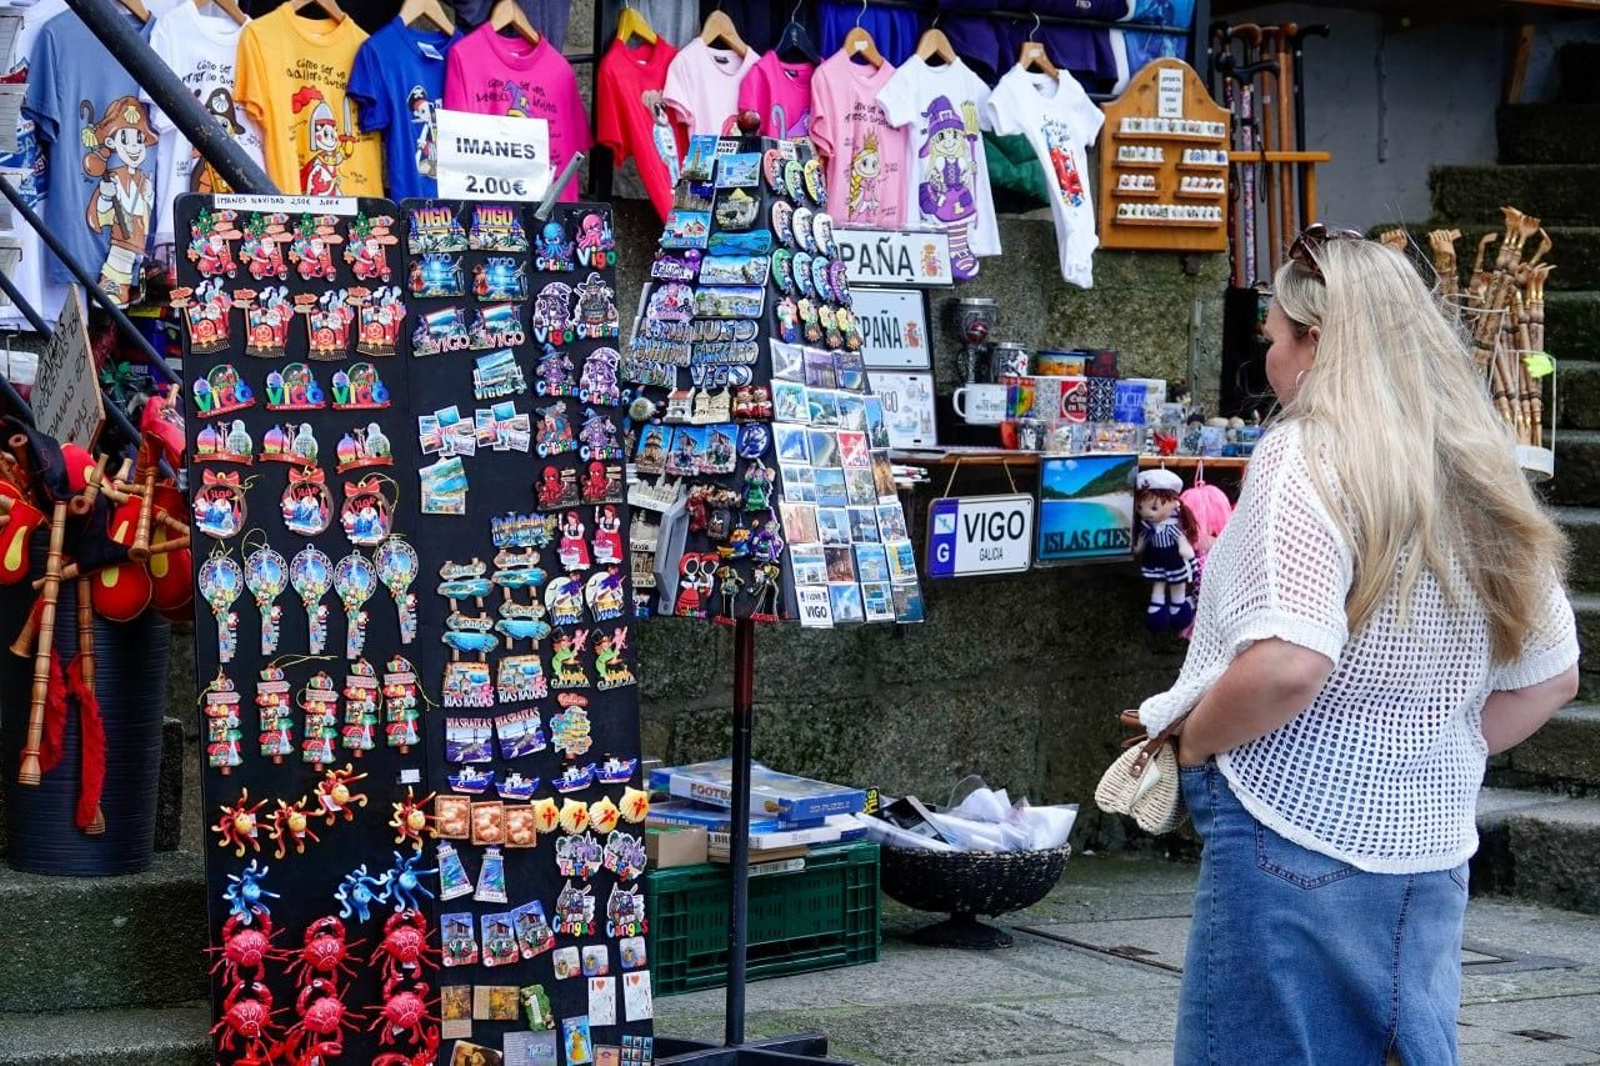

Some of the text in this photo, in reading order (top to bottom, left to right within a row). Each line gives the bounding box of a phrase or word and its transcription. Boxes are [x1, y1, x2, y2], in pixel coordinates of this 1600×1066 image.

[456, 137, 536, 160] IMANES
[465, 175, 527, 196] 2.00€
[216, 197, 247, 205] IMANES
[251, 197, 285, 206] NAVIDAD
[414, 207, 452, 226] VIGO
[478, 206, 514, 226] VIGO
[423, 253, 451, 263] VIGO
[487, 257, 515, 267] VIGO
[576, 247, 618, 269] Vigo
[839, 236, 915, 276] PAÑA
[535, 327, 574, 346] Vigo
[964, 510, 1025, 543] VIGO
[1043, 529, 1090, 550] ISLAS
[937, 543, 949, 562] G
[979, 548, 1003, 561] GALICIA
[805, 605, 827, 618] VIGO
[551, 677, 591, 689] GALICIA
[597, 676, 637, 691] GALICIA
[552, 914, 596, 937] Cangas
[606, 918, 650, 938] Cangas
